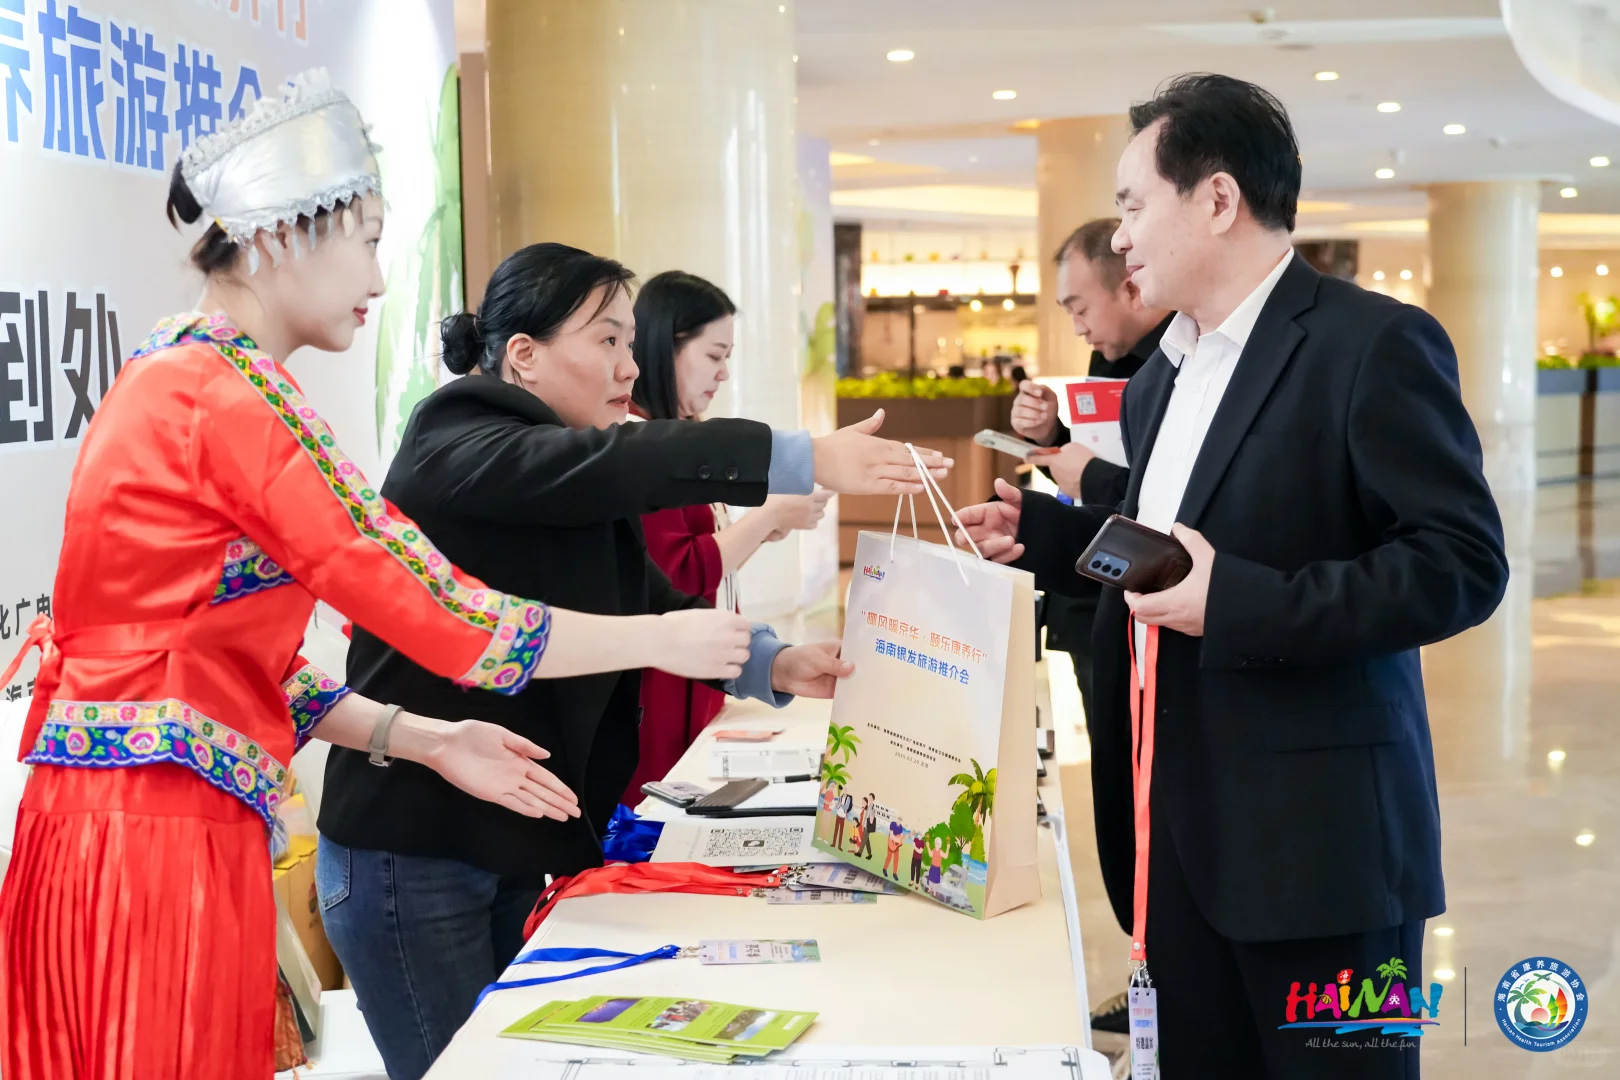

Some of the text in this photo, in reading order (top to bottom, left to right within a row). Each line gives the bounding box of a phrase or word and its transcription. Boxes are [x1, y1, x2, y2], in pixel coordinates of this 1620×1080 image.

[875, 638, 970, 685] 海南银发旅游推介会
